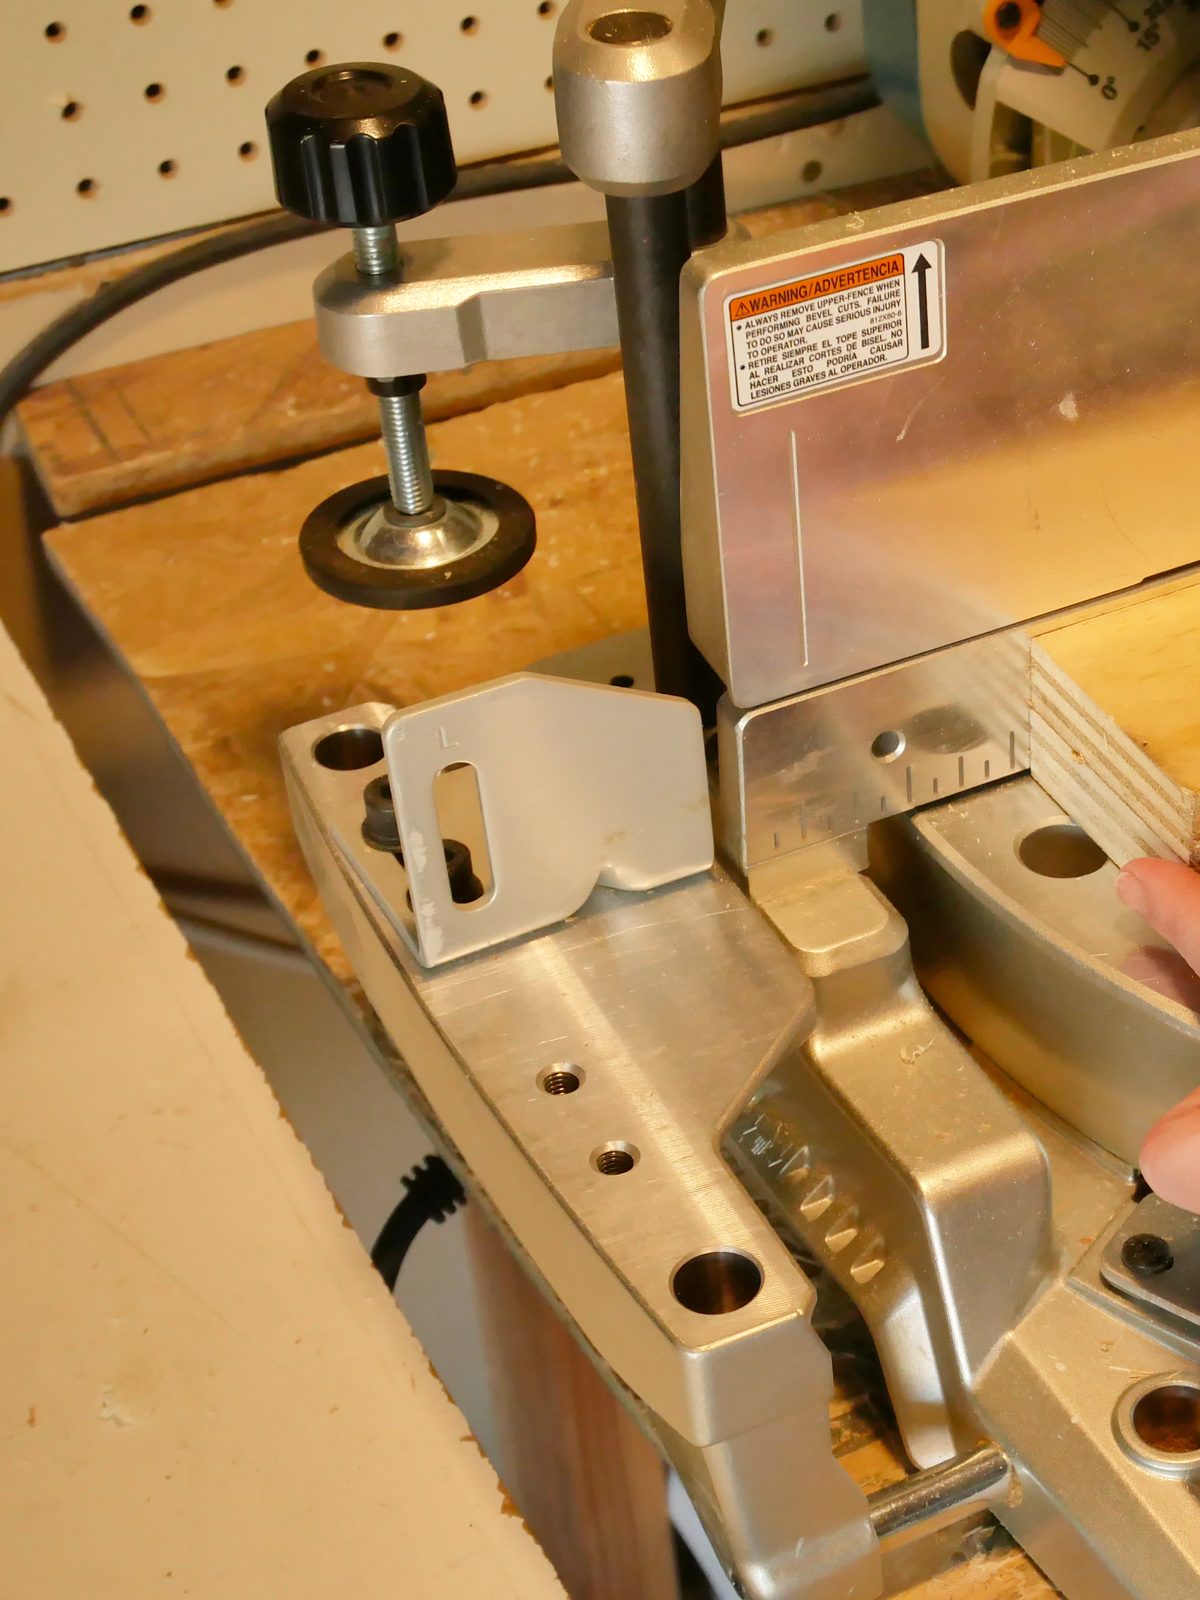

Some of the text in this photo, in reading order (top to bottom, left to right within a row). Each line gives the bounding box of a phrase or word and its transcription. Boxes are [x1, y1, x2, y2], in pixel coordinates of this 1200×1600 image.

[745, 279, 900, 329] ALWAYS REMOVE UPPER-FENCE WHEN
[749, 260, 899, 312] WARNING/ADVERTENCIA
[745, 317, 801, 339] PERFORMING
[806, 308, 833, 322] BEVEL
[867, 288, 901, 305] FAILURE
[746, 298, 901, 349] TO DO SO MAY CAUSE SERIOUS INJURY
[747, 336, 808, 360] TO OPERATOR.
[748, 319, 902, 370] RETIRE SIEMPRE EL TOPE SUPERIOR
[749, 328, 903, 380] AL REALIZAR CORTES DE BISEL. NO
[749, 339, 903, 390] HACER ESTO PODRÍA CAUSAR
[750, 353, 887, 400] LESIONES GRAVES AL OPERADOR.
